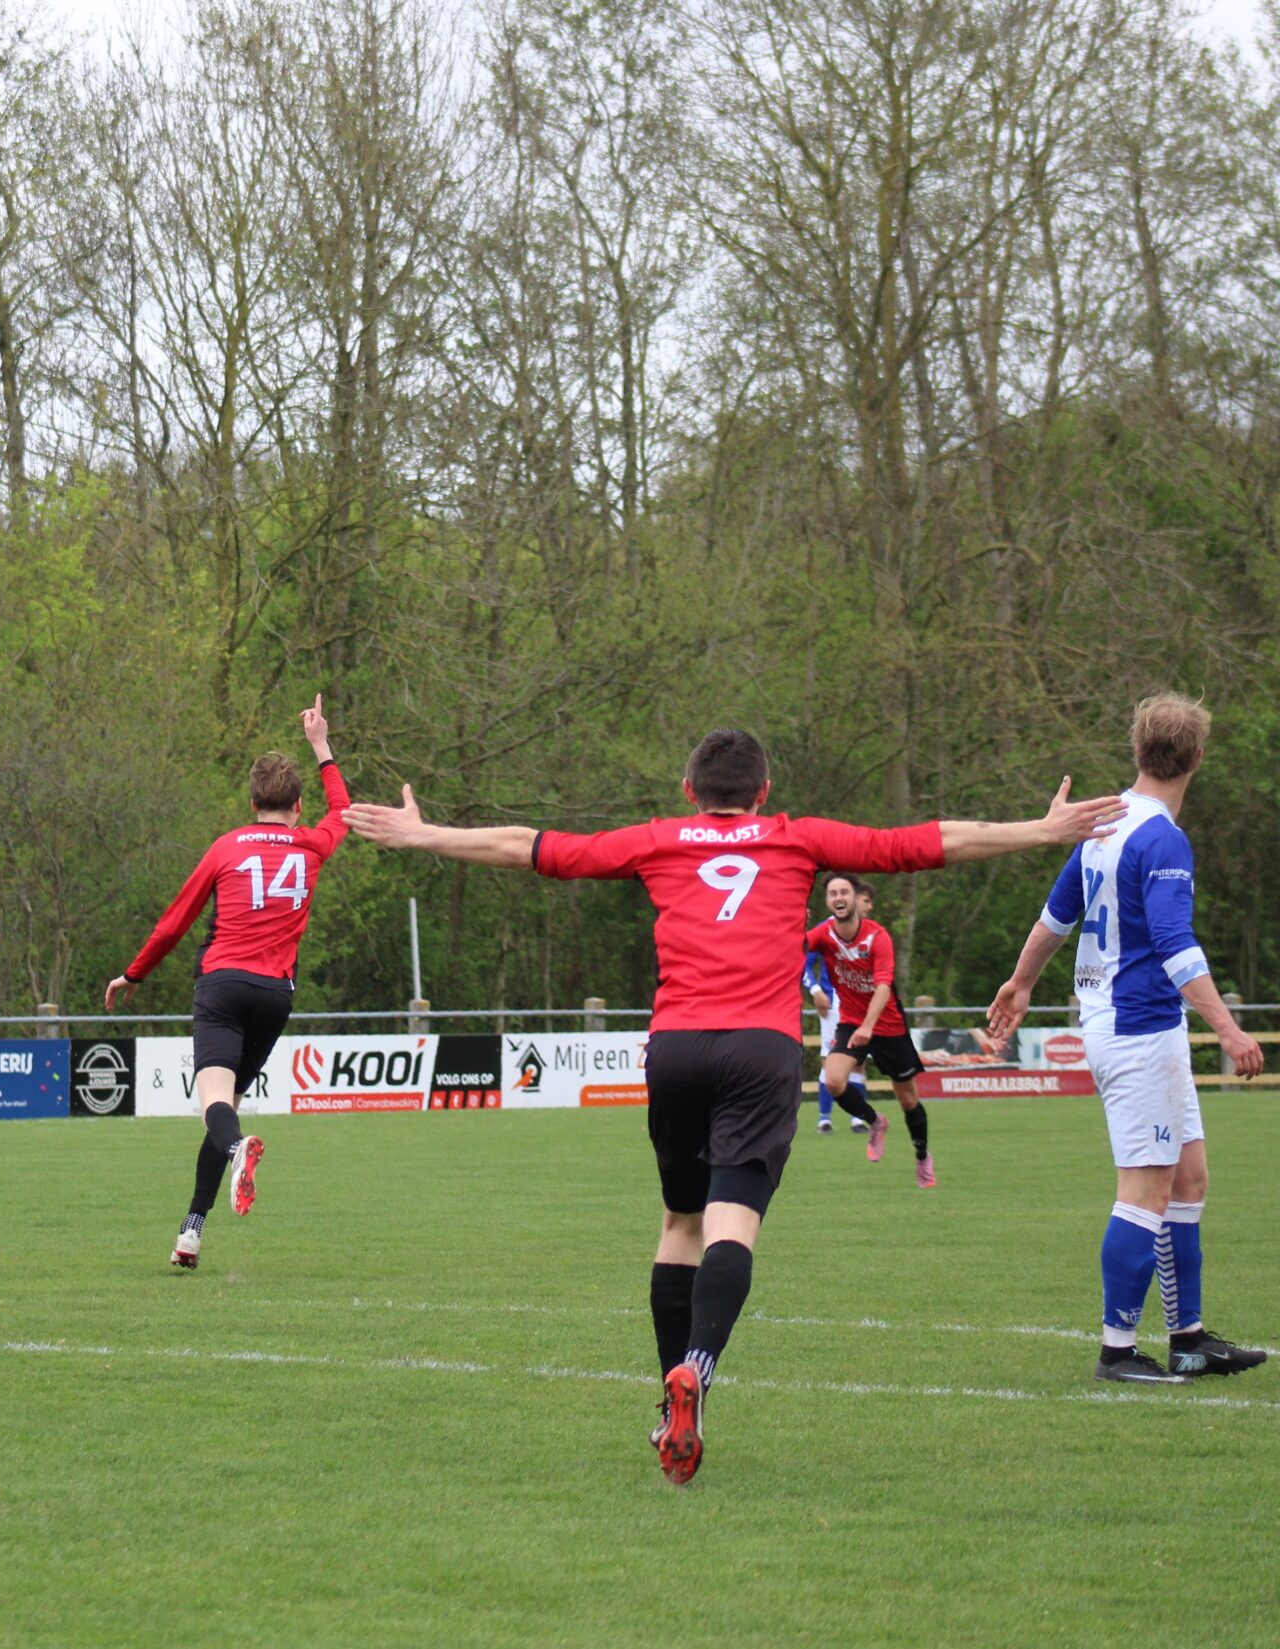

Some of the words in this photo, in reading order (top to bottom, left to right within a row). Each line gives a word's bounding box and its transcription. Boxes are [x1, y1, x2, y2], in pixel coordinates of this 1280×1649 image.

[234, 853, 309, 911] 14
[696, 854, 761, 921] 9
[554, 1042, 587, 1077] Mij
[593, 1049, 630, 1070] een
[152, 1068, 164, 1089] &
[435, 1073, 460, 1086] VOLG
[461, 1073, 480, 1086] ONS
[480, 1072, 495, 1085] OP
[295, 1097, 353, 1110] 247kooi.com
[1153, 1125, 1171, 1143] 14
